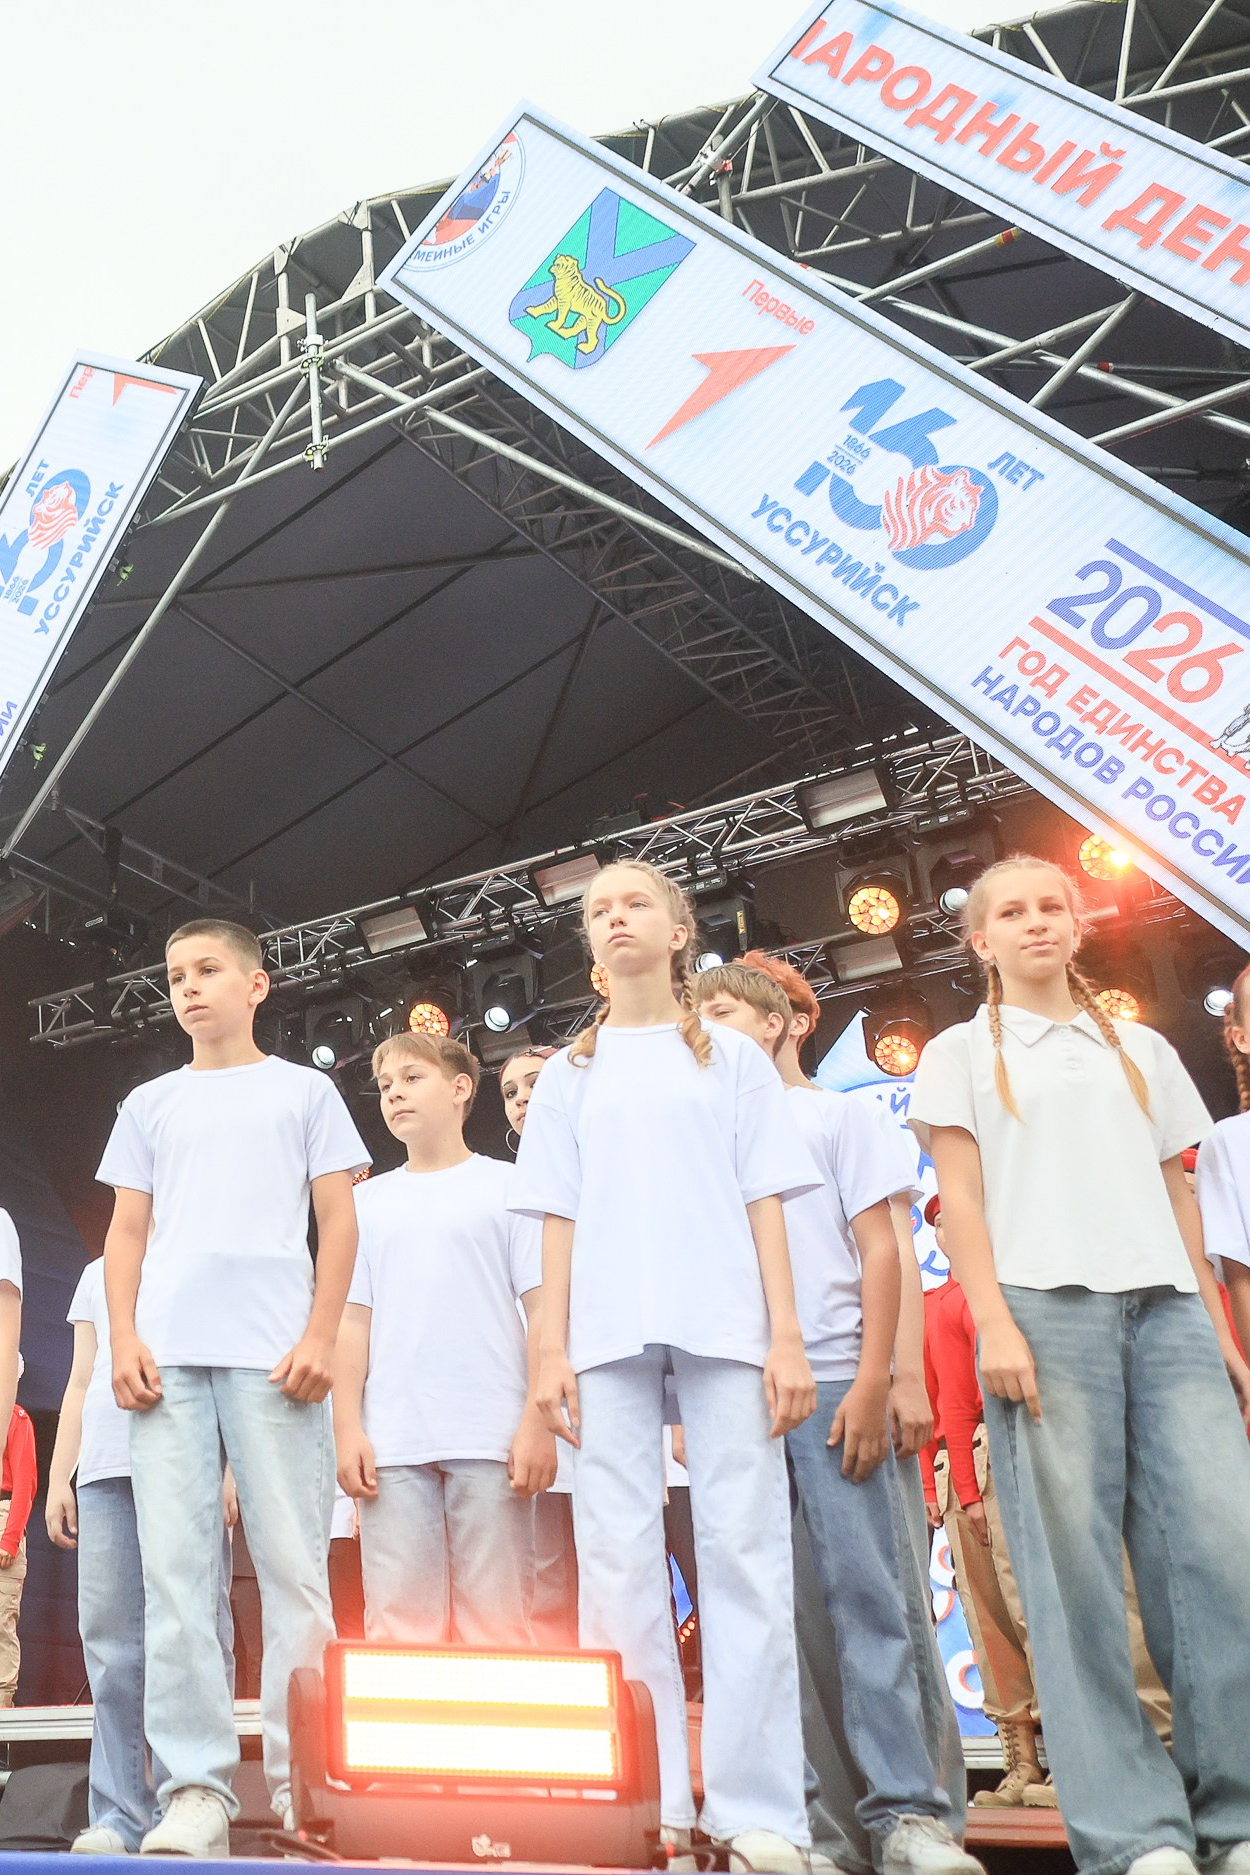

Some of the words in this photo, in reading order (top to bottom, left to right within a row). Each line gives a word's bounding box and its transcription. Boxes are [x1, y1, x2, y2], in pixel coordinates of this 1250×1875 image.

[478, 191, 511, 234] ИГРЫ
[1101, 182, 1250, 288] ДЕН
[741, 279, 816, 336] Первые
[25, 459, 50, 498] ЛЕТ
[827, 450, 857, 476] 2026
[842, 434, 872, 459] 1866
[987, 451, 1046, 491] ЛЕТ
[34, 481, 125, 635] УССУРИЙСК
[750, 493, 920, 627] УССУРИЙСК
[1045, 559, 1245, 703] 2026
[998, 636, 1071, 700] ГОД
[1065, 684, 1248, 826] ЕДИНСТВА
[970, 665, 1126, 785] НАРОДОВ
[1121, 776, 1250, 885] РОССИ
